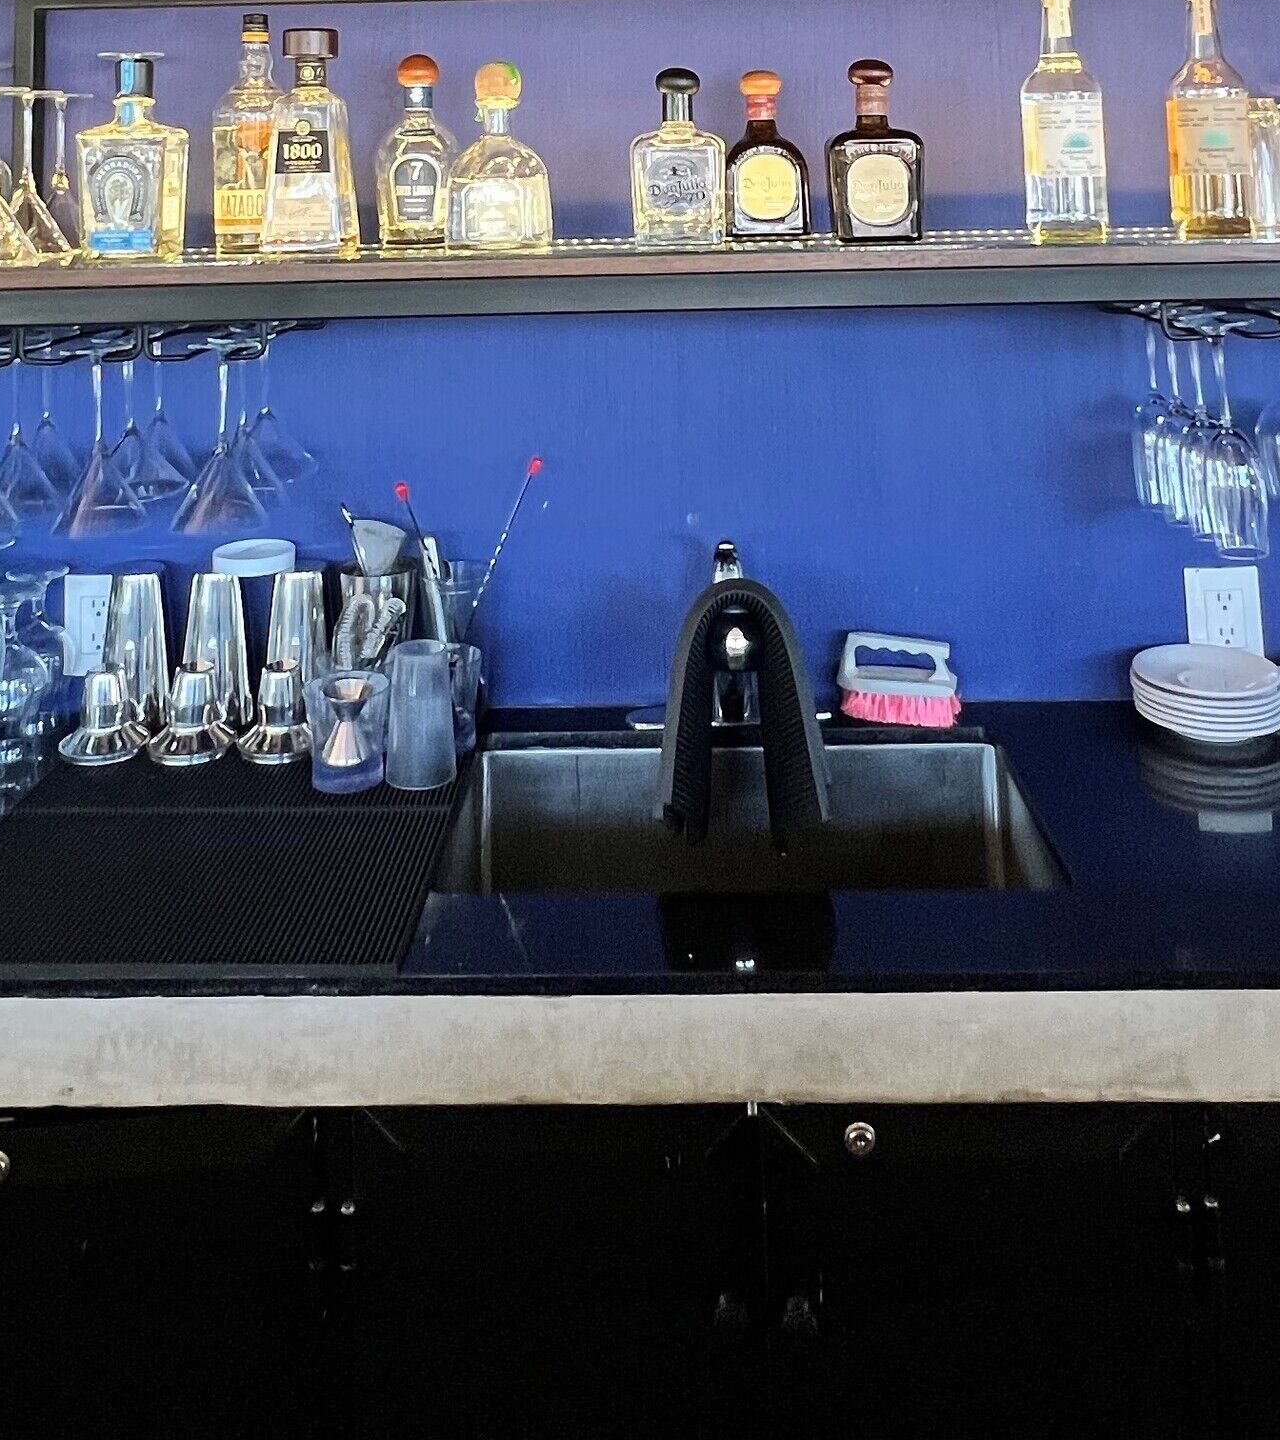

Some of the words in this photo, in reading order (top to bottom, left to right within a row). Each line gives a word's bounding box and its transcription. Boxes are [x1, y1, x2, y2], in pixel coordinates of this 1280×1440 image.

[282, 142, 323, 160] 1800
[410, 161, 423, 181] 7
[685, 191, 706, 203] 70
